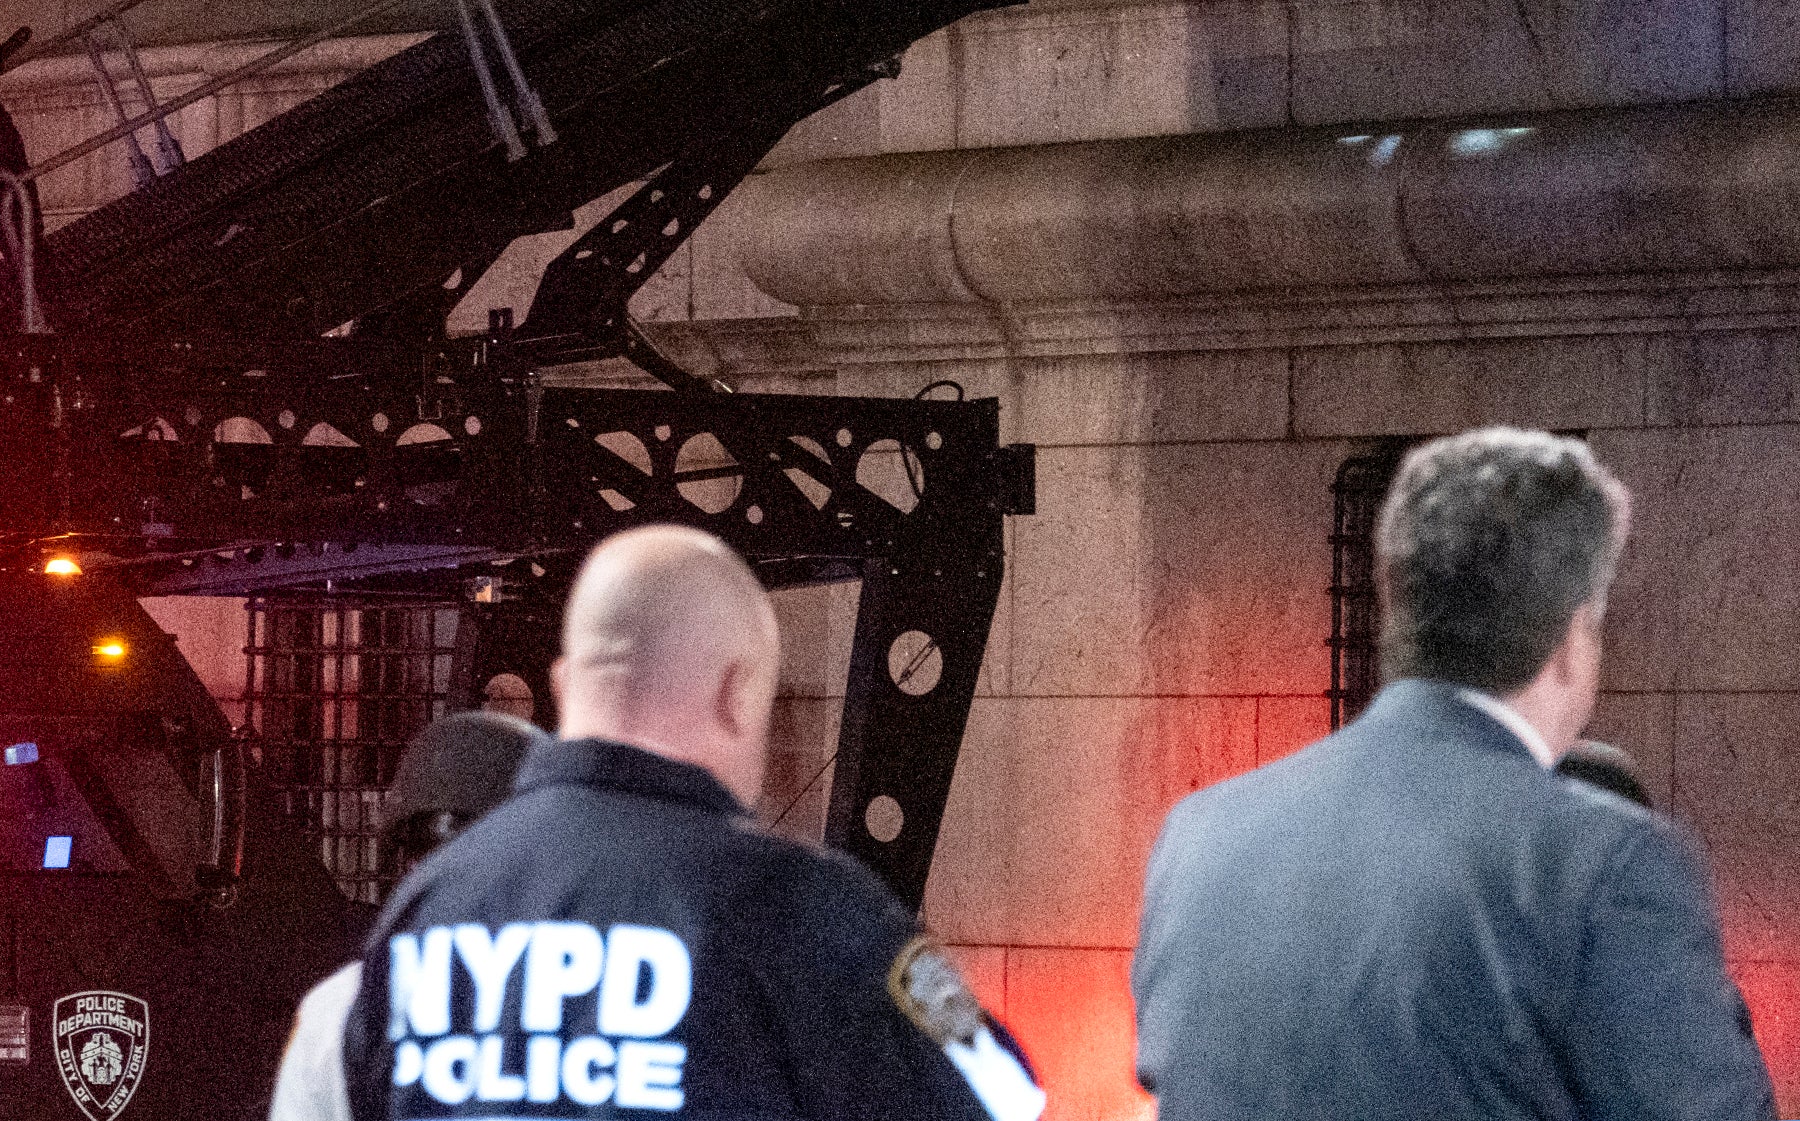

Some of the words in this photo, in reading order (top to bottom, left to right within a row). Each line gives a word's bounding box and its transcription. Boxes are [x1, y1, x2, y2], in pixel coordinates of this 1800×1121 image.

[76, 996, 126, 1014] POLICE
[389, 921, 692, 1041] NYPD
[59, 1011, 144, 1038] DEPARTMENT
[61, 1049, 78, 1081] CITY
[75, 1087, 90, 1101] OF
[107, 1085, 129, 1112] NEW
[127, 1045, 143, 1079] YORK
